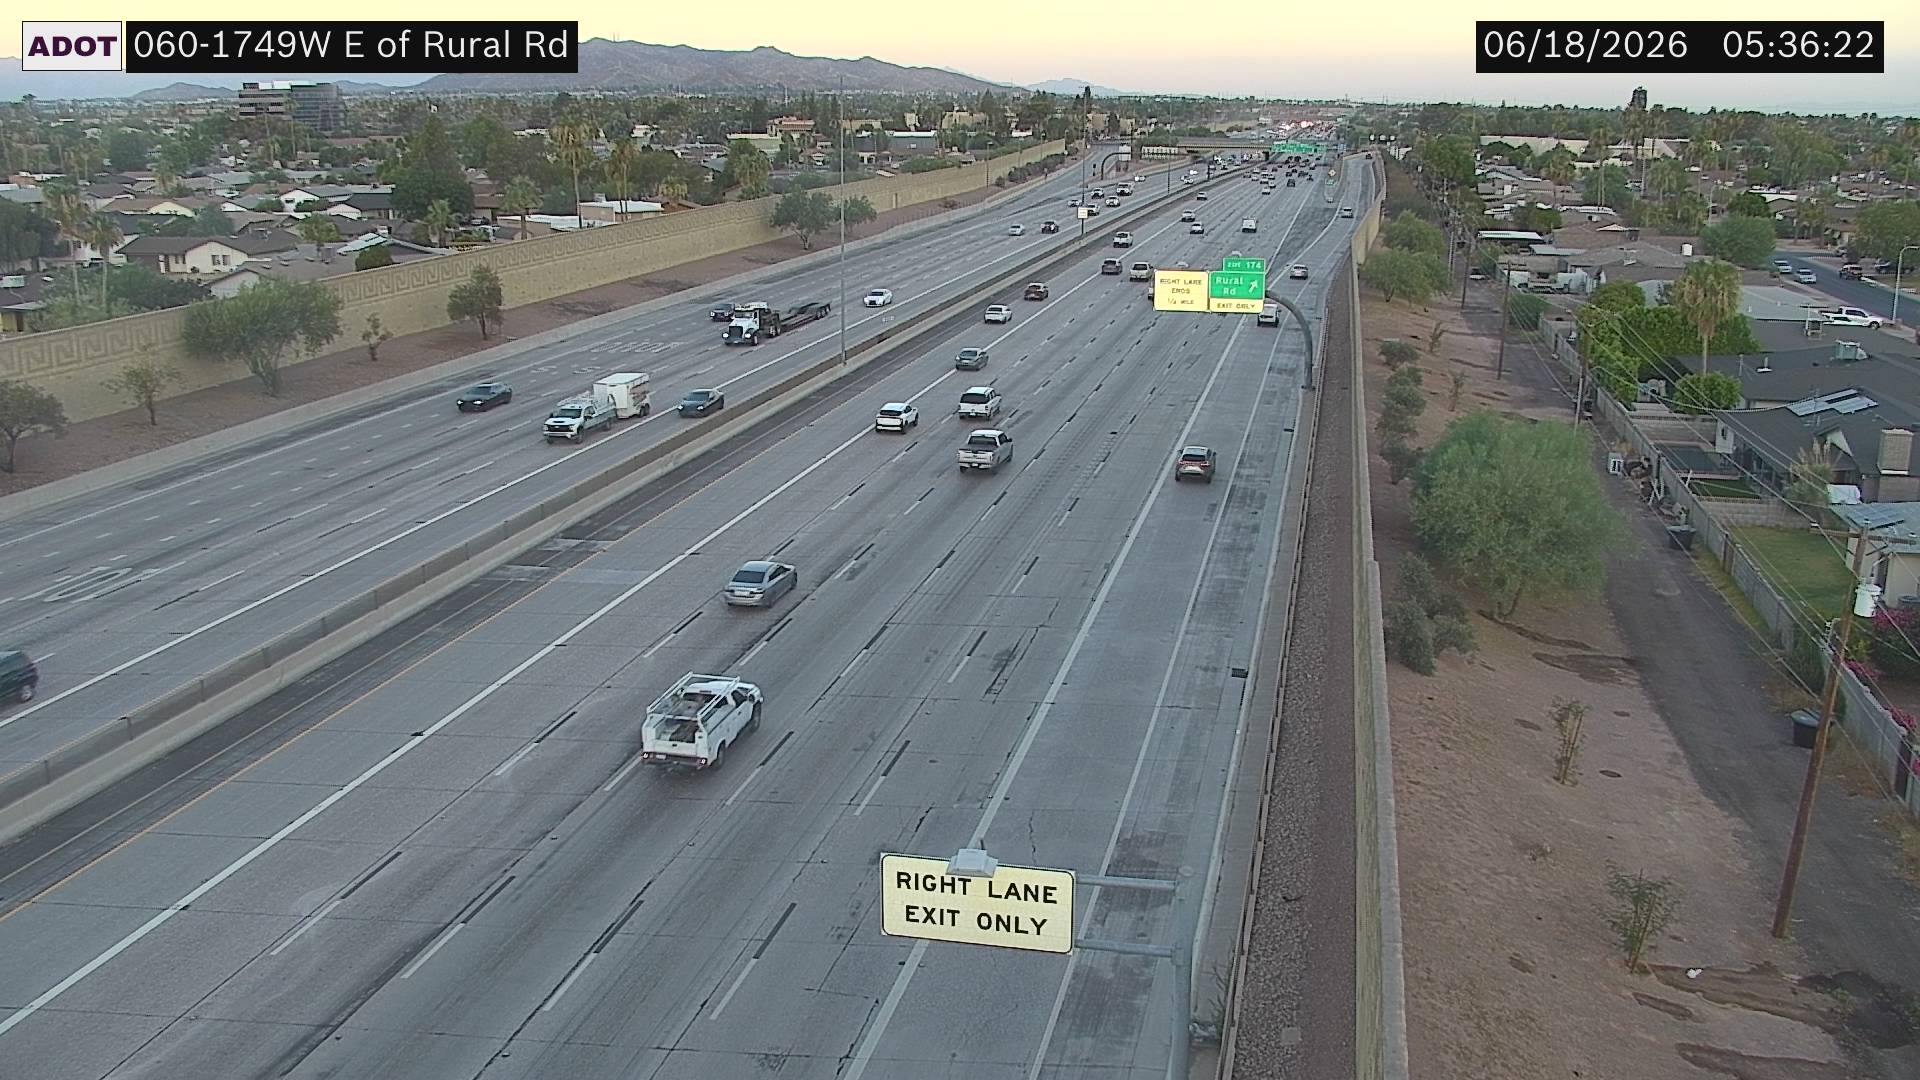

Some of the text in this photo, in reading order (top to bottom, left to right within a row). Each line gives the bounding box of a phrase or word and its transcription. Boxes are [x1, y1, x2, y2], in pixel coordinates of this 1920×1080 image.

[1246, 261, 1262, 269] 174
[1216, 276, 1243, 285] Rural
[1223, 287, 1237, 296] Rd
[896, 871, 1058, 904] RIGHT LANE
[905, 904, 1048, 936] EXIT ONLY
